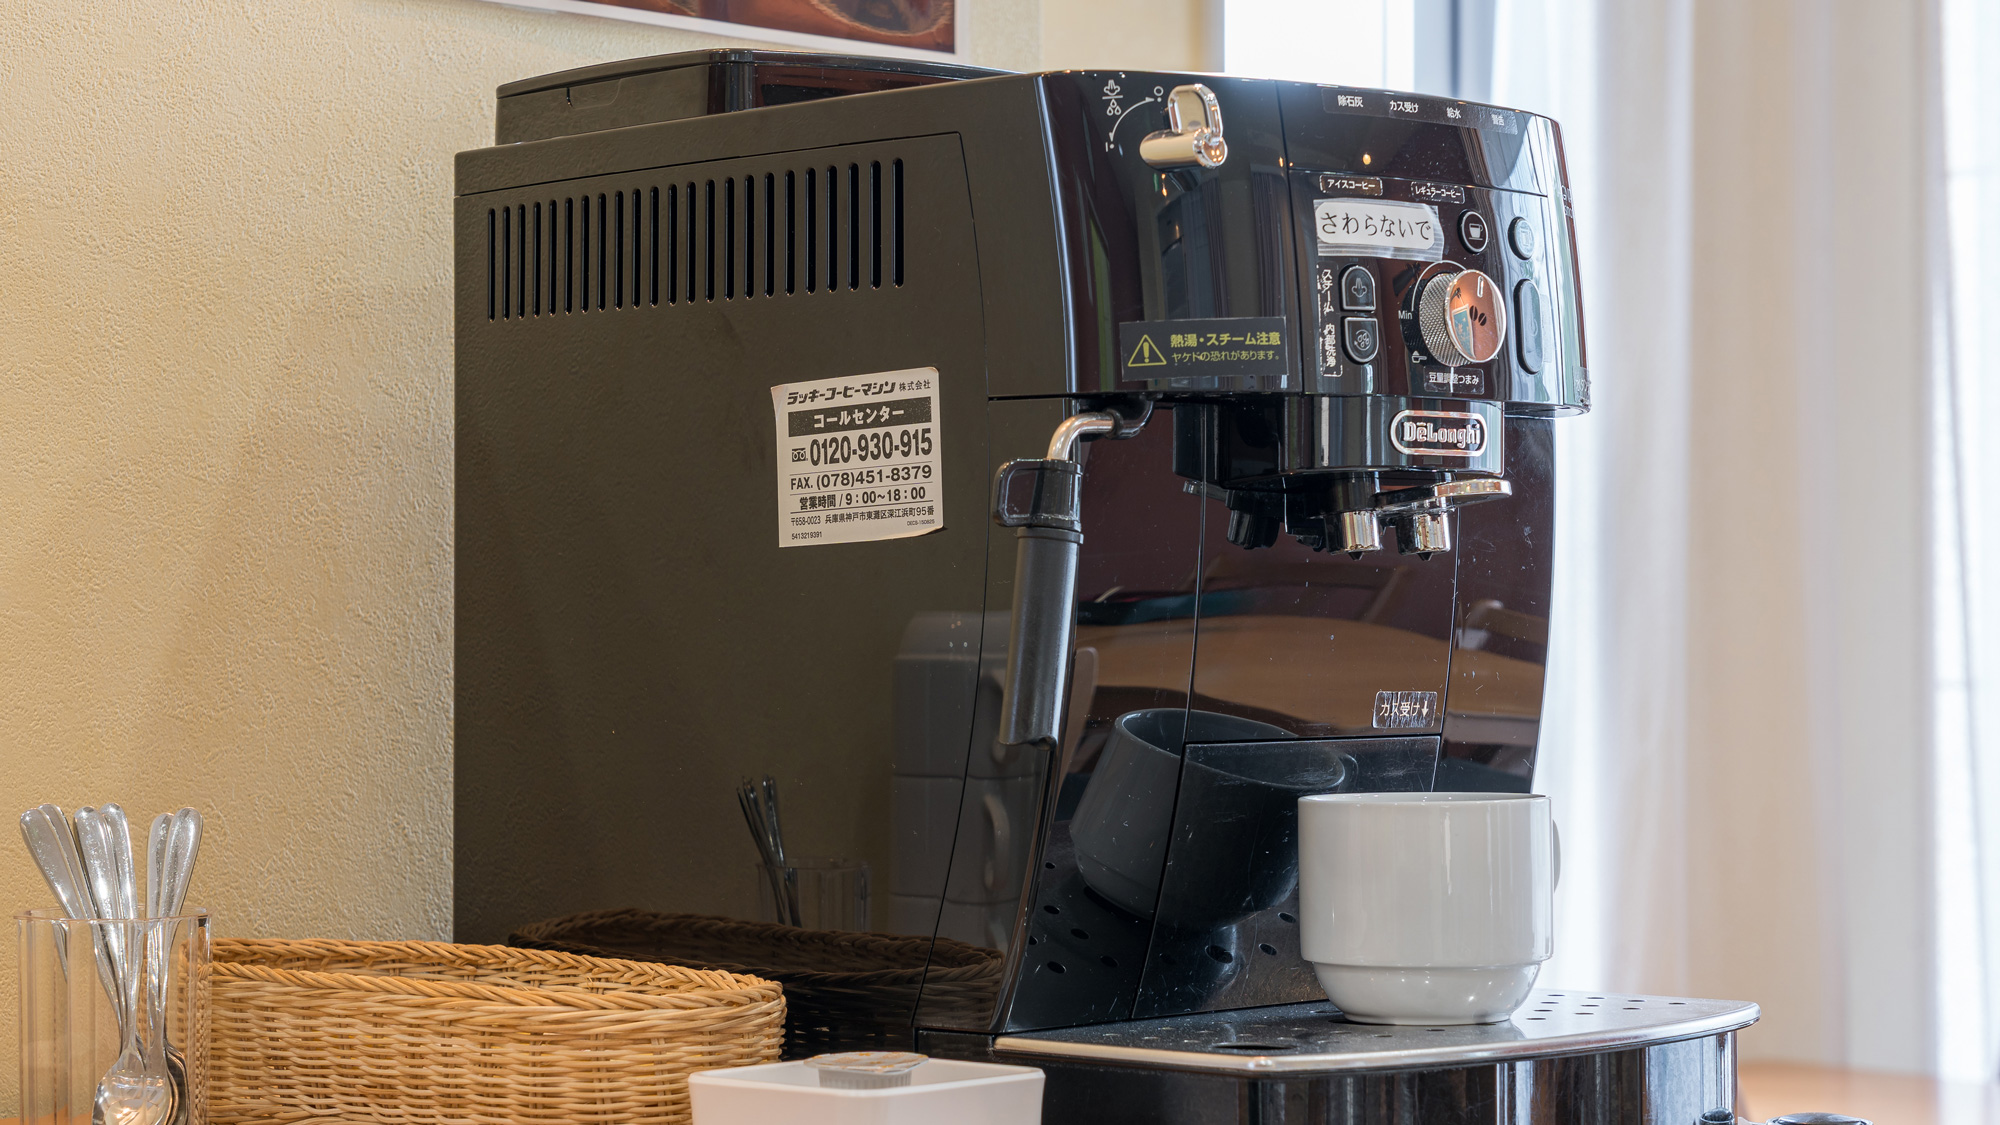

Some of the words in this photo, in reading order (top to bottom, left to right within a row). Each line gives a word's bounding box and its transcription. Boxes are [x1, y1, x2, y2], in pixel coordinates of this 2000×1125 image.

[1337, 94, 1364, 109] 除石灰
[1389, 99, 1419, 114] カス受け
[1446, 107, 1462, 120] 給水
[1327, 178, 1376, 190] アイスコーヒー
[1415, 185, 1462, 199] レギュラーコーヒー
[1320, 212, 1432, 241] さわらないで
[1398, 310, 1413, 321] Min
[1170, 331, 1281, 348] 熱湯・スチーム注意
[1171, 350, 1280, 363] ヤケドの恐れがあります。
[787, 381, 897, 406] ラッキーコーヒーマシン
[898, 379, 931, 393] 株式会社
[814, 405, 905, 429] コールセンター
[810, 428, 933, 467] 0120-930-915
[790, 476, 813, 491] FAX.
[816, 464, 933, 491] (078)451-8379
[824, 505, 935, 525] 兵庫県神戸市東灘区深江浜町95番
[1379, 701, 1421, 717] カス受け
